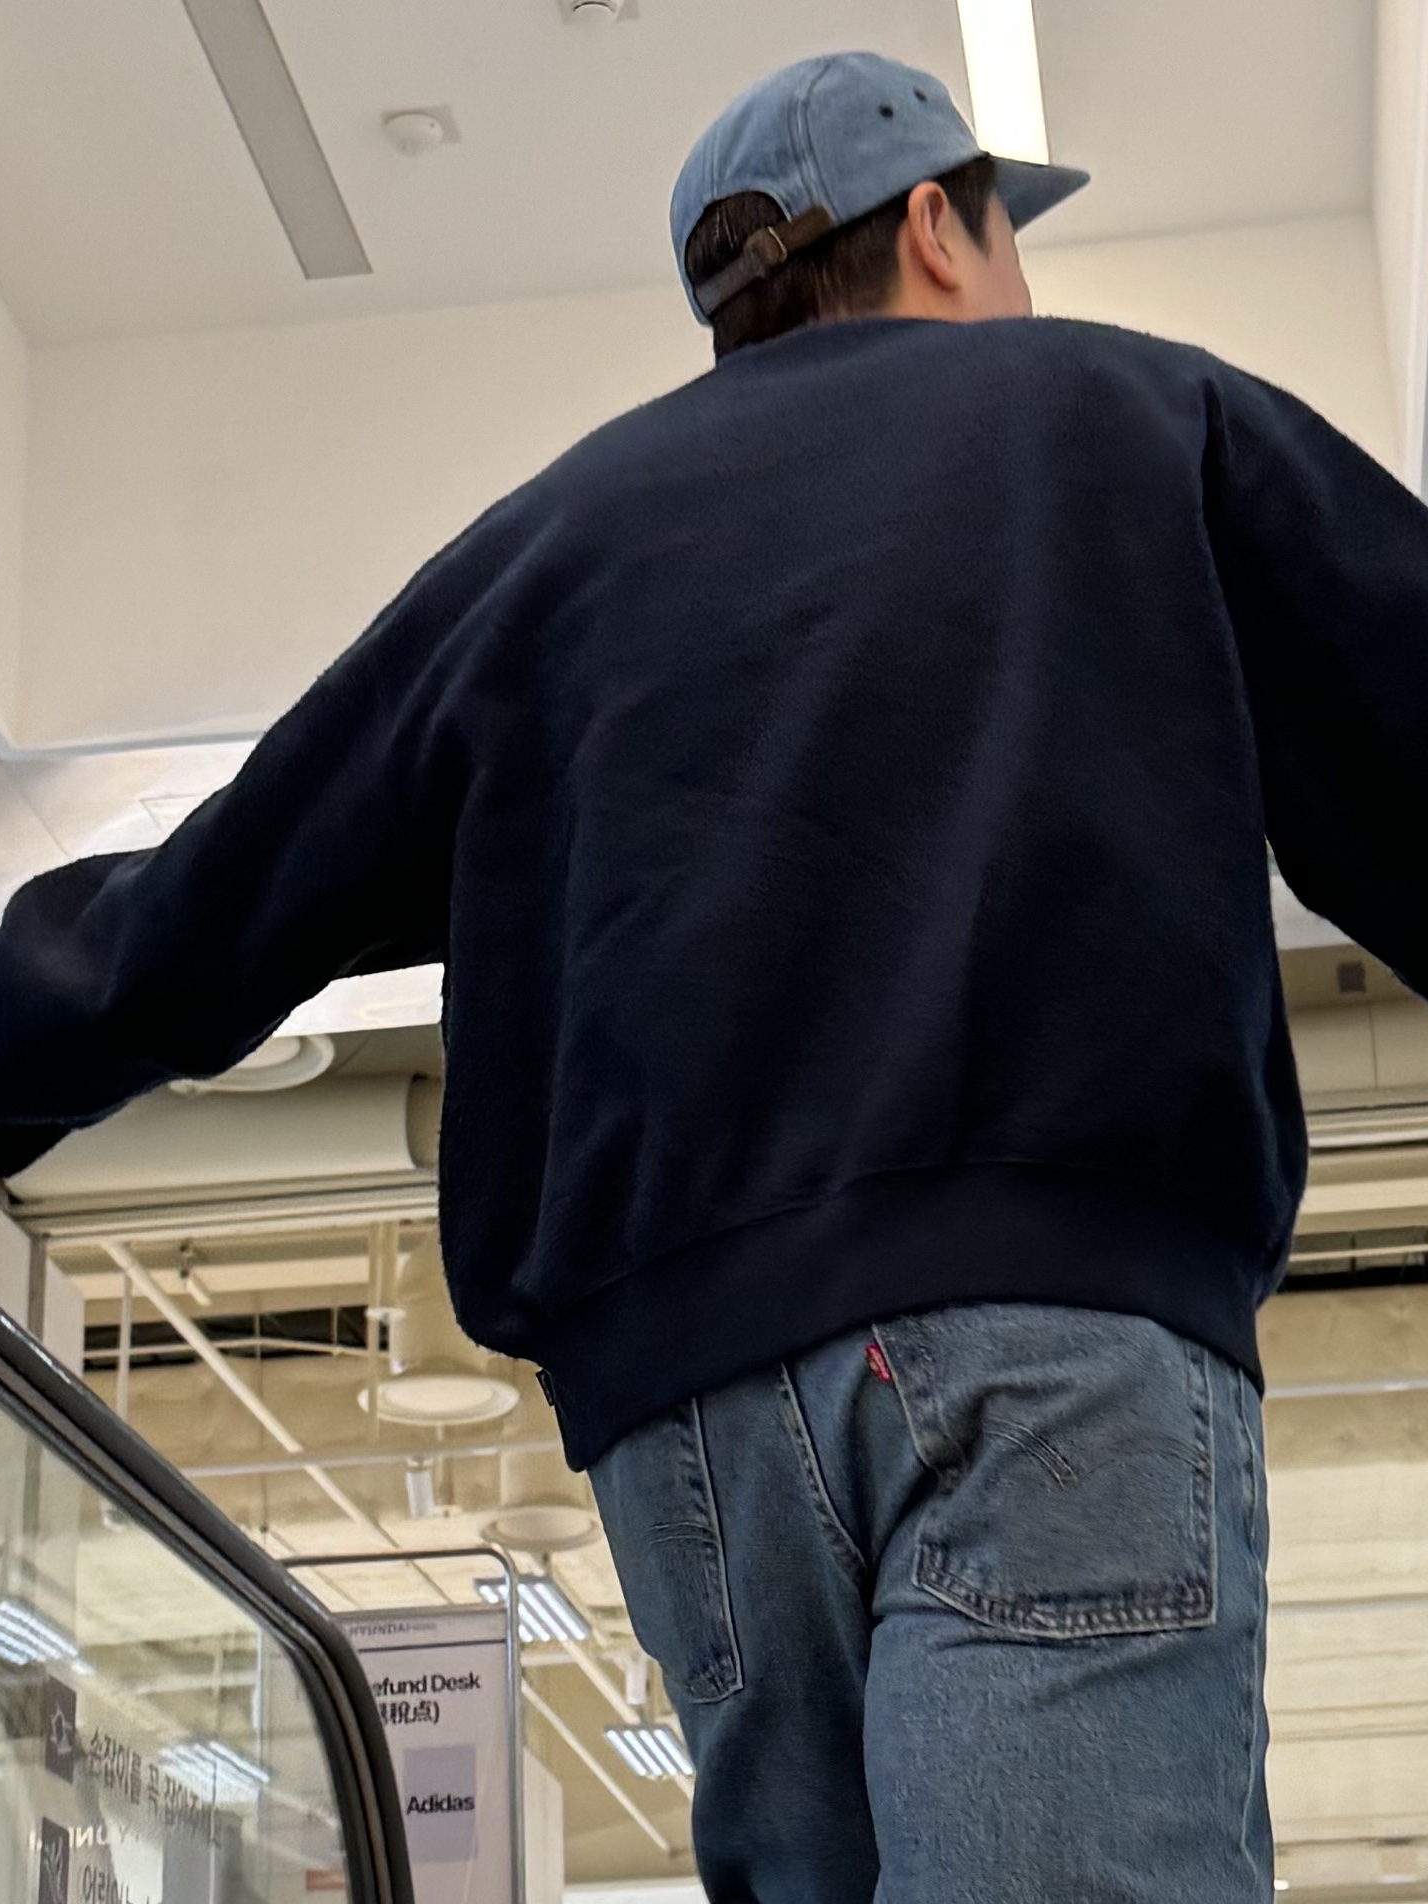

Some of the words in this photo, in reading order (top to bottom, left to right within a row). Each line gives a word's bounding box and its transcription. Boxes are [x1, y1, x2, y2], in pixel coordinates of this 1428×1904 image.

[372, 1674, 427, 1697] efund
[431, 1672, 481, 1693] Desk
[406, 1792, 475, 1816] Adidas
